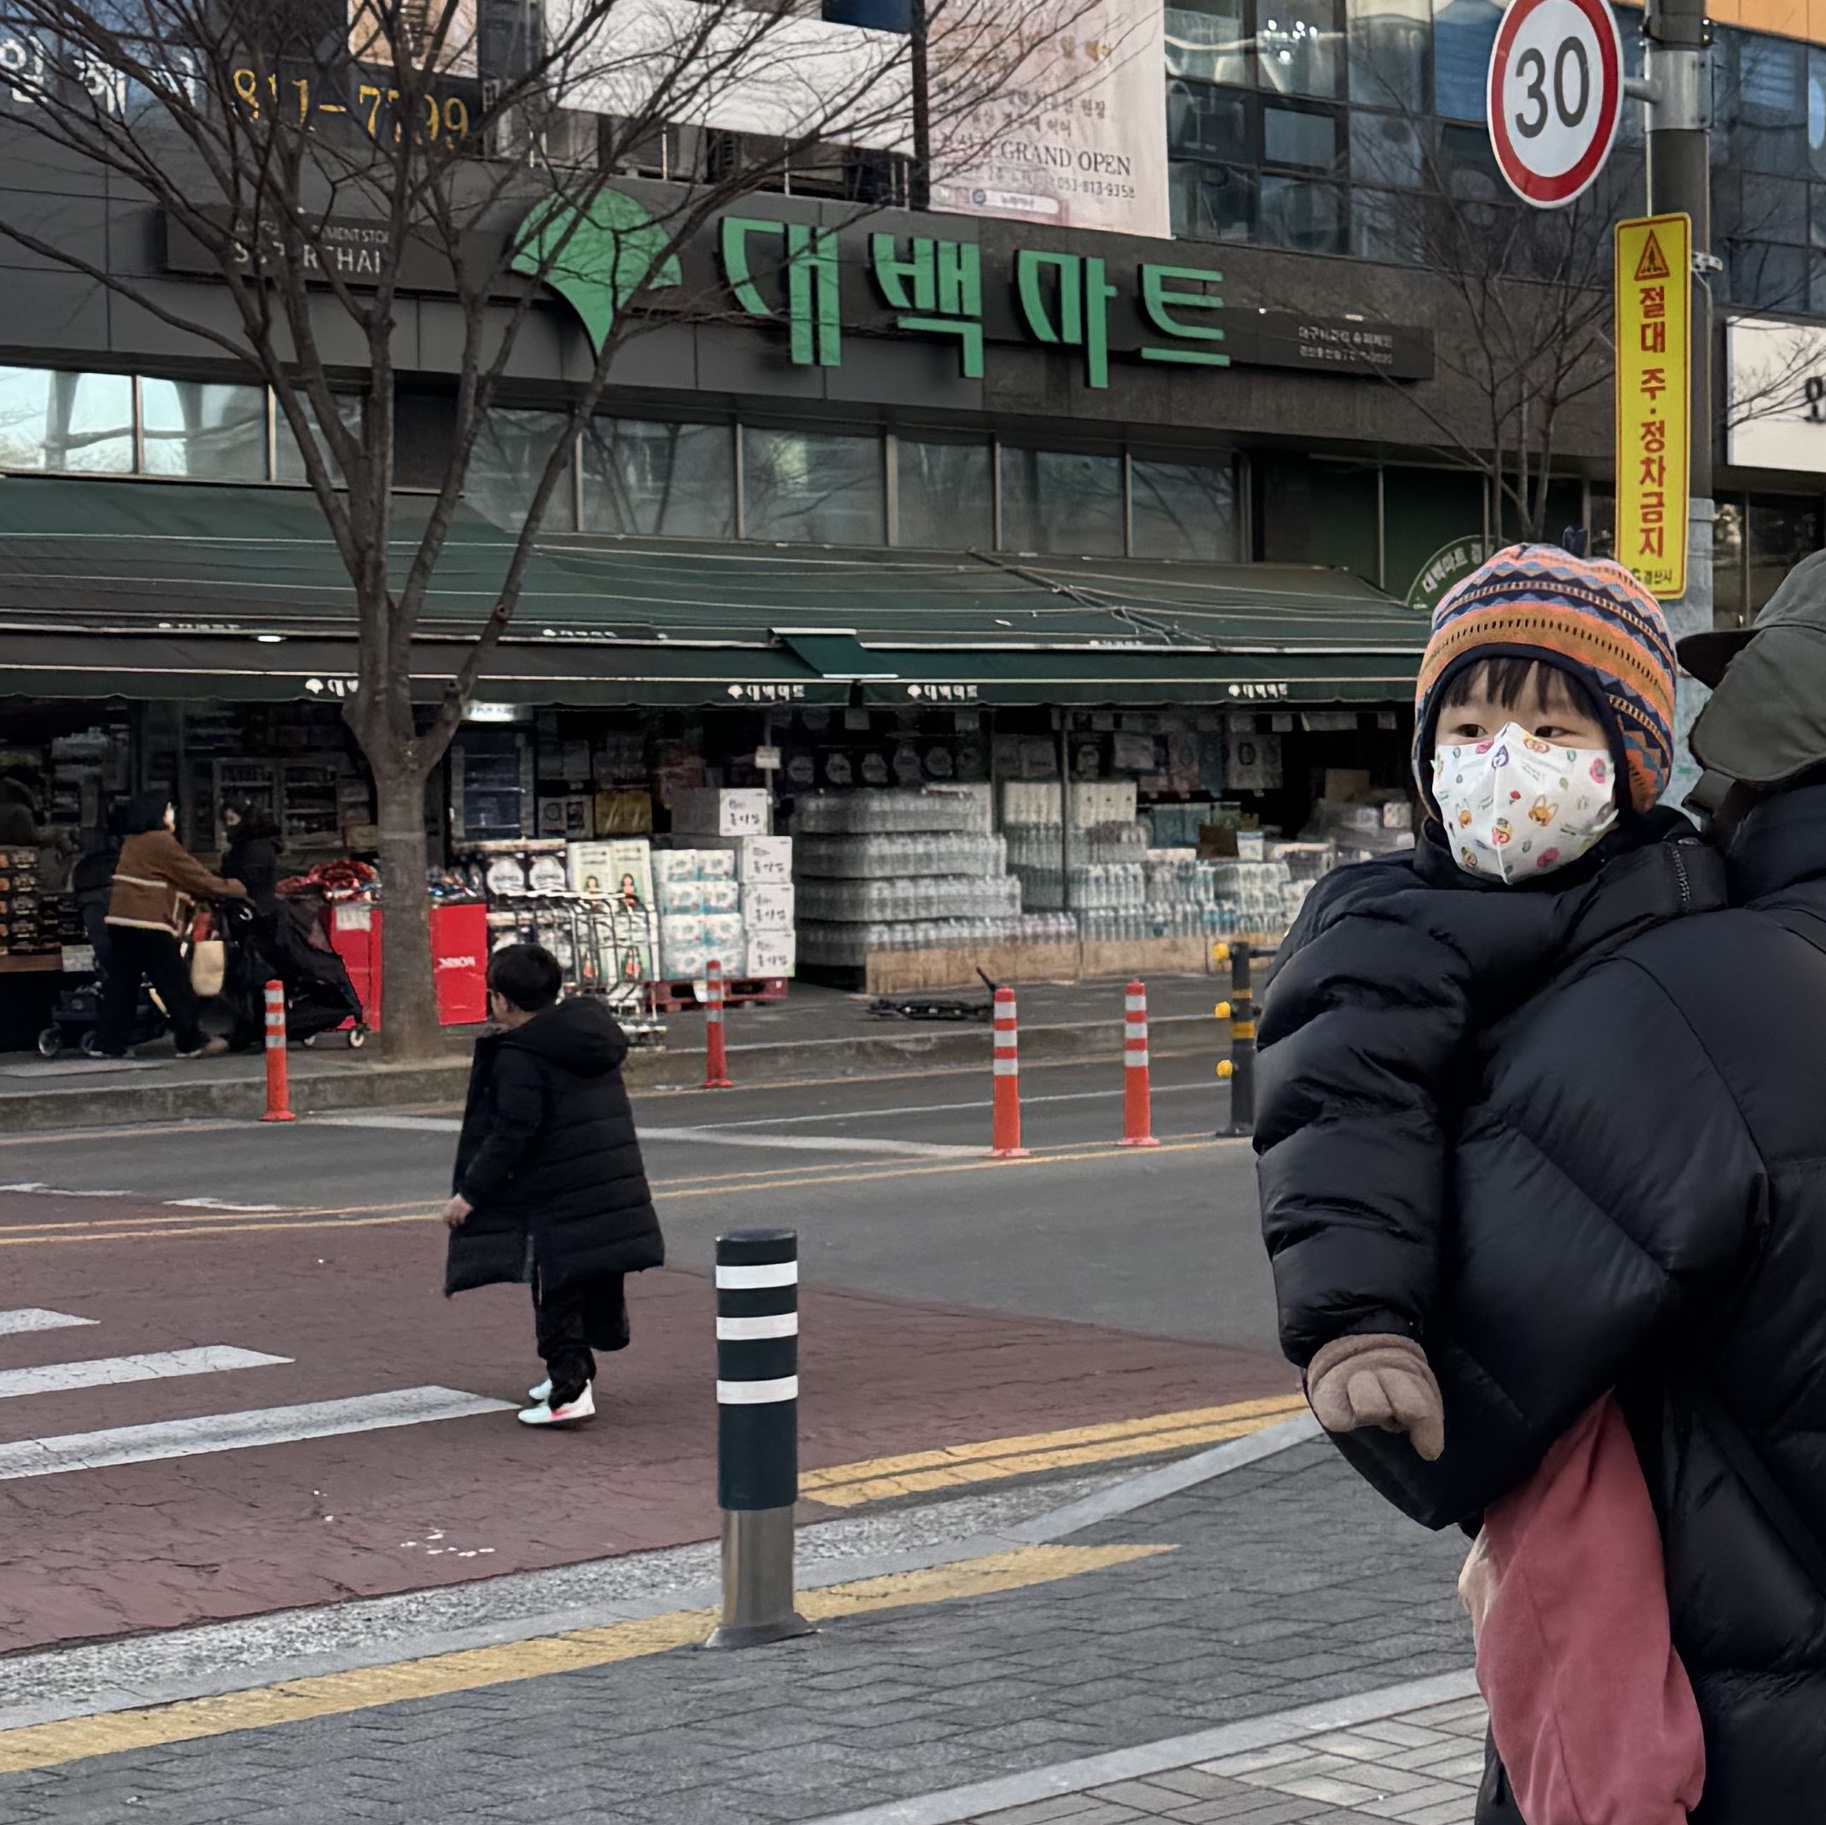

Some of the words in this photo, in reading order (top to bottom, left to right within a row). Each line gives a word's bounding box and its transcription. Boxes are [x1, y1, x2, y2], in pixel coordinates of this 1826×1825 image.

[1516, 36, 1590, 138] 30
[1000, 140, 1072, 168] GRAND
[1077, 150, 1132, 177] OPEN
[720, 215, 1231, 389] 대백마트
[1639, 286, 1667, 353] 절대
[1644, 568, 1673, 585] 경산시
[745, 684, 805, 701] 대백마트
[924, 684, 979, 701] 대백마트
